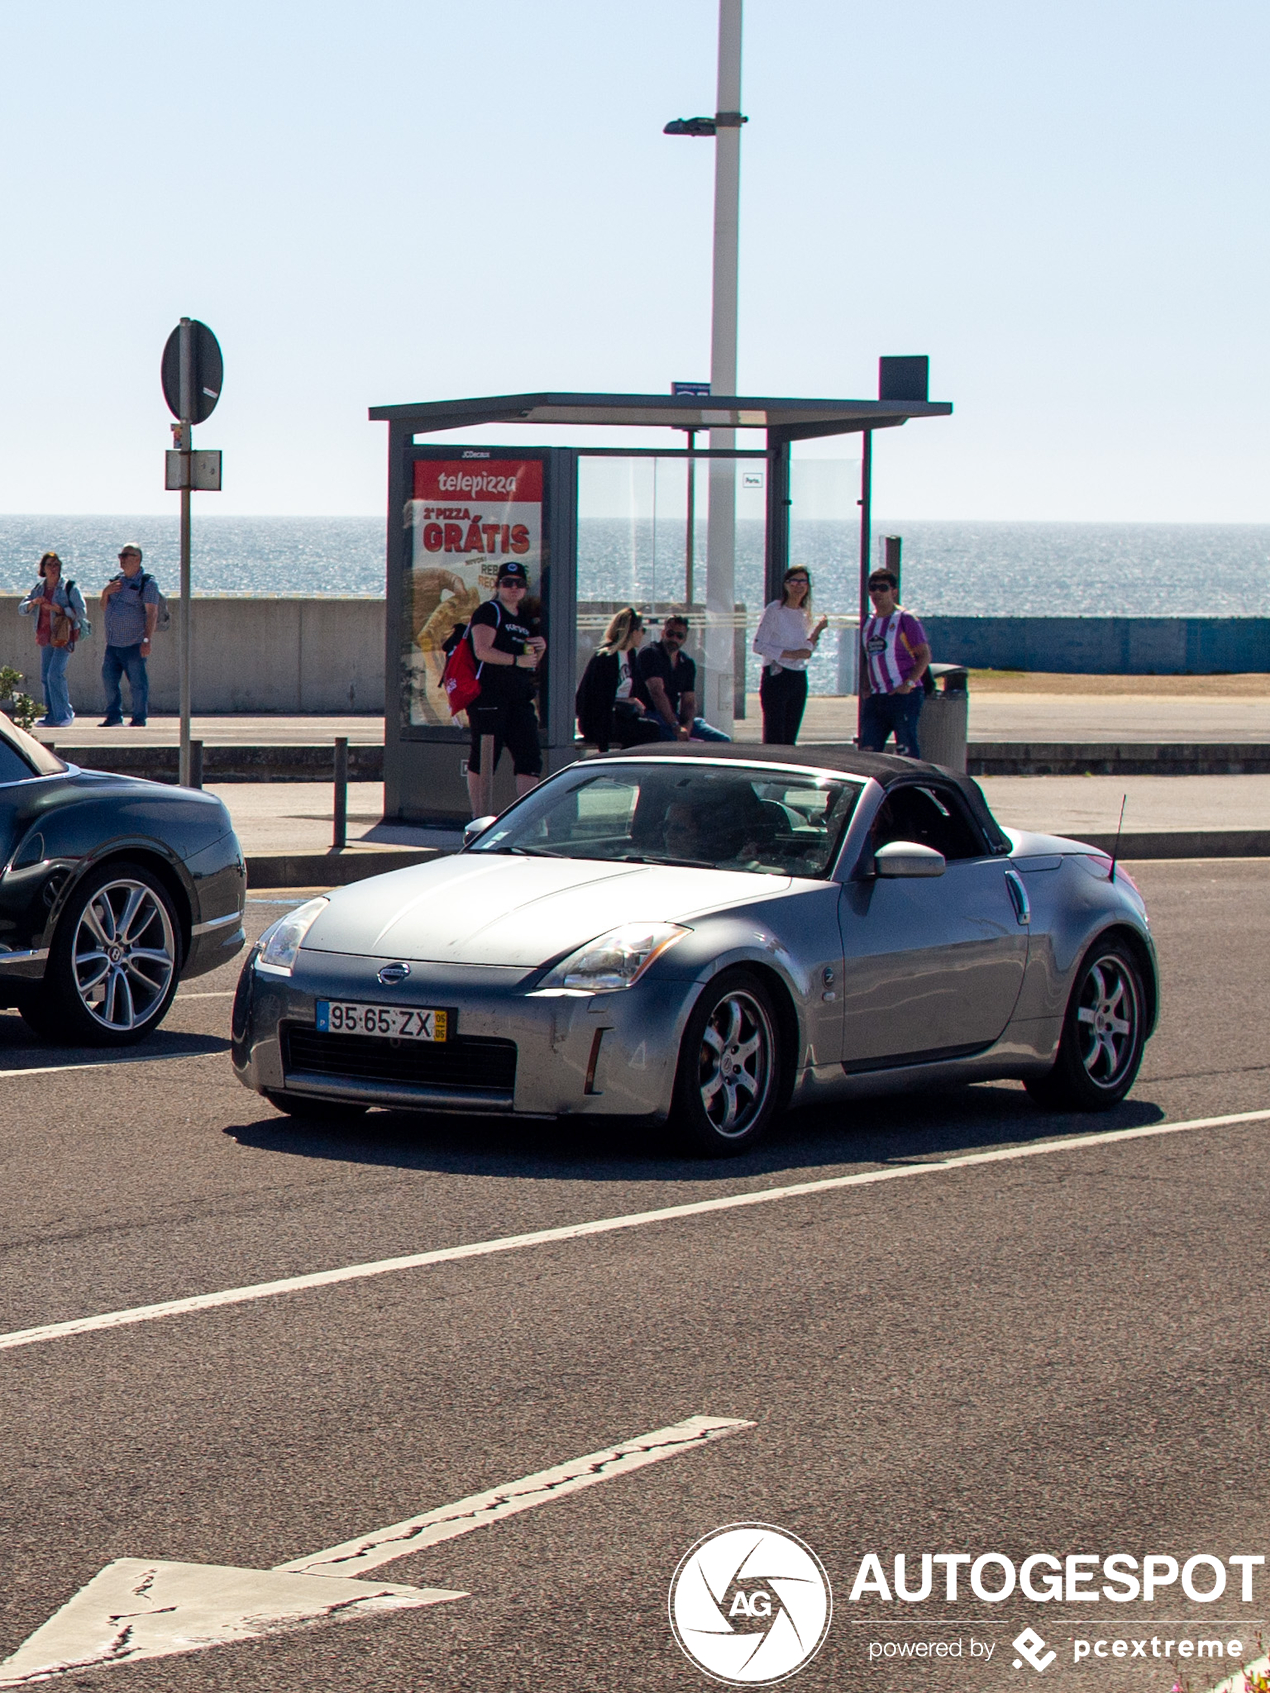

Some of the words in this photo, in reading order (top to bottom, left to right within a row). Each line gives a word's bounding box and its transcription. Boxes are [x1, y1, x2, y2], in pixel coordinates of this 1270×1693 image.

[438, 471, 517, 499] telepizza
[435, 507, 471, 520] PIZZA
[423, 514, 530, 555] GRÁTIS
